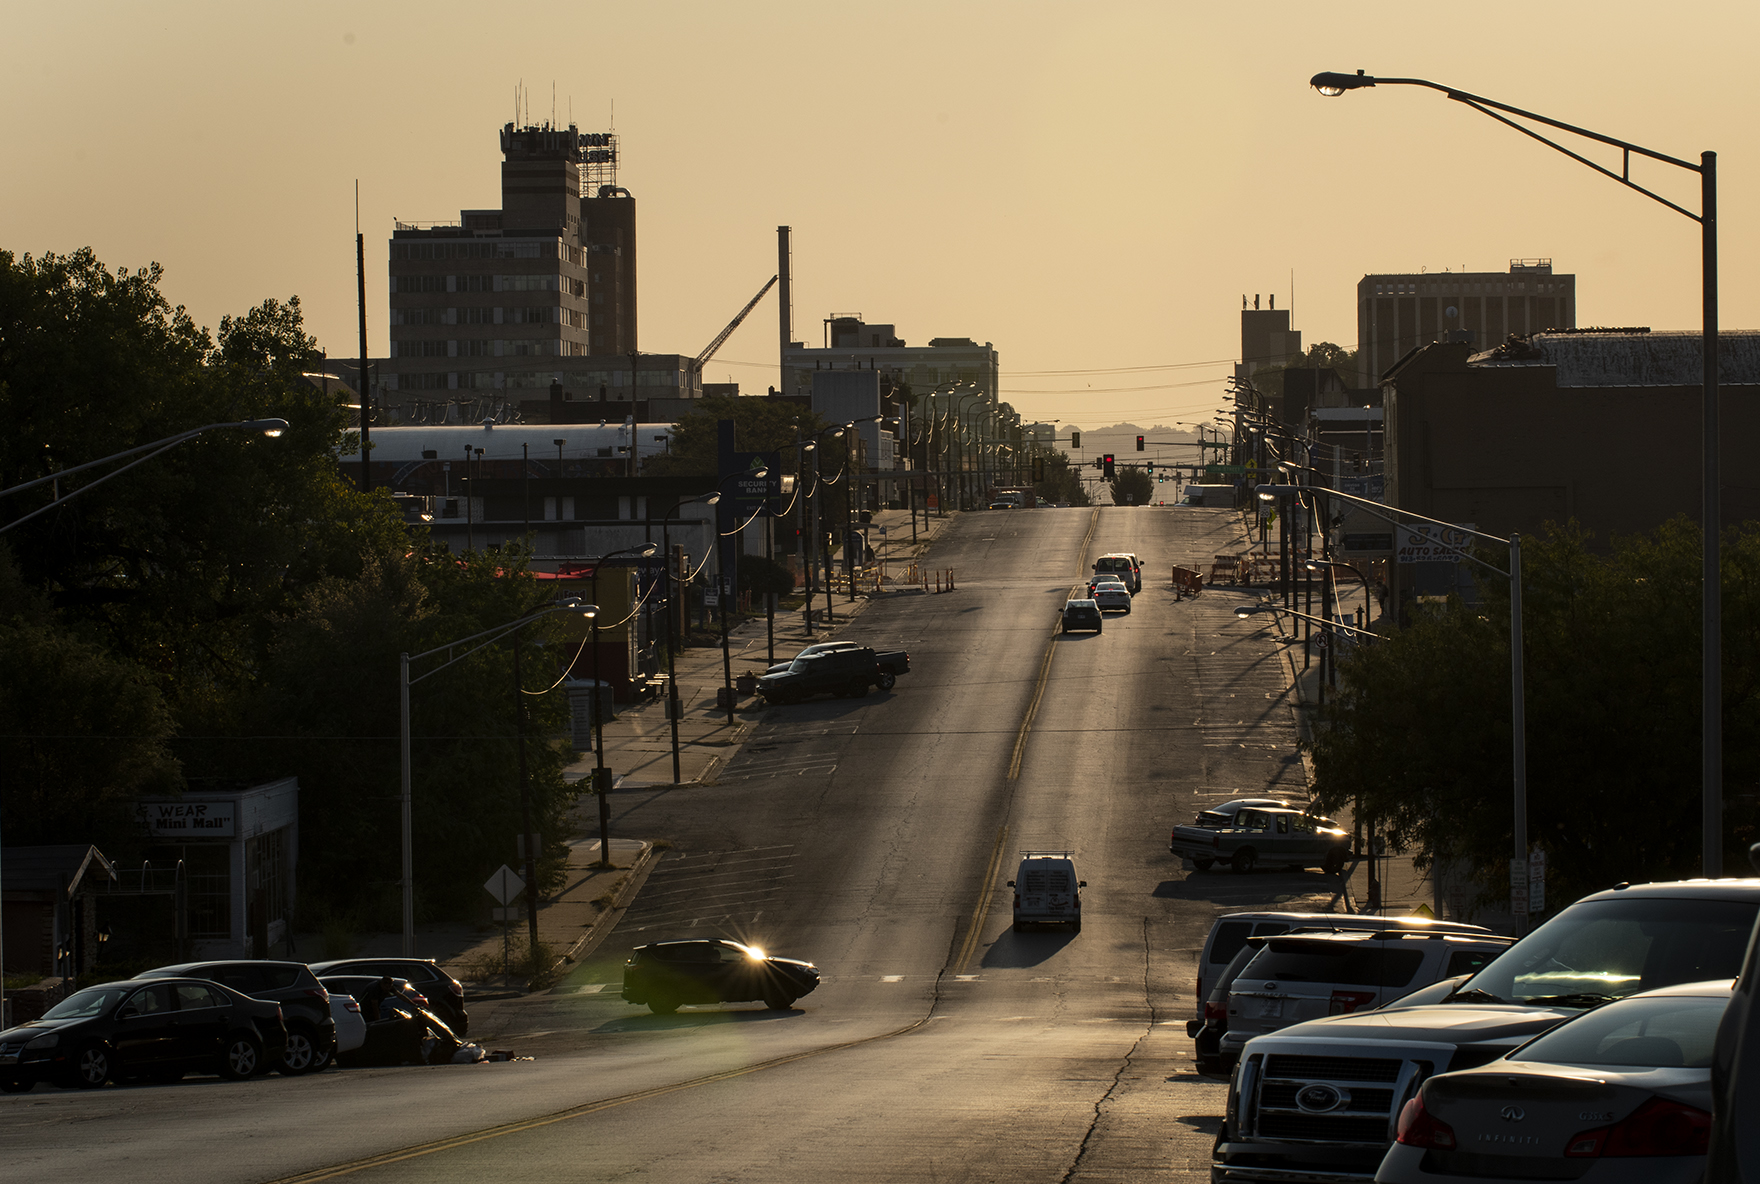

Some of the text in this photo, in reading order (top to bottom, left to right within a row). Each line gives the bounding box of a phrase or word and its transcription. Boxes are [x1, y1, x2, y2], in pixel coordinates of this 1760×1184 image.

[738, 480, 777, 488] SECURIY
[1399, 546, 1431, 556] AUTO
[158, 805, 208, 818] WEAR
[156, 818, 187, 829] Mini
[193, 817, 230, 828] Mall"
[1478, 1134, 1540, 1145] INFINITI
